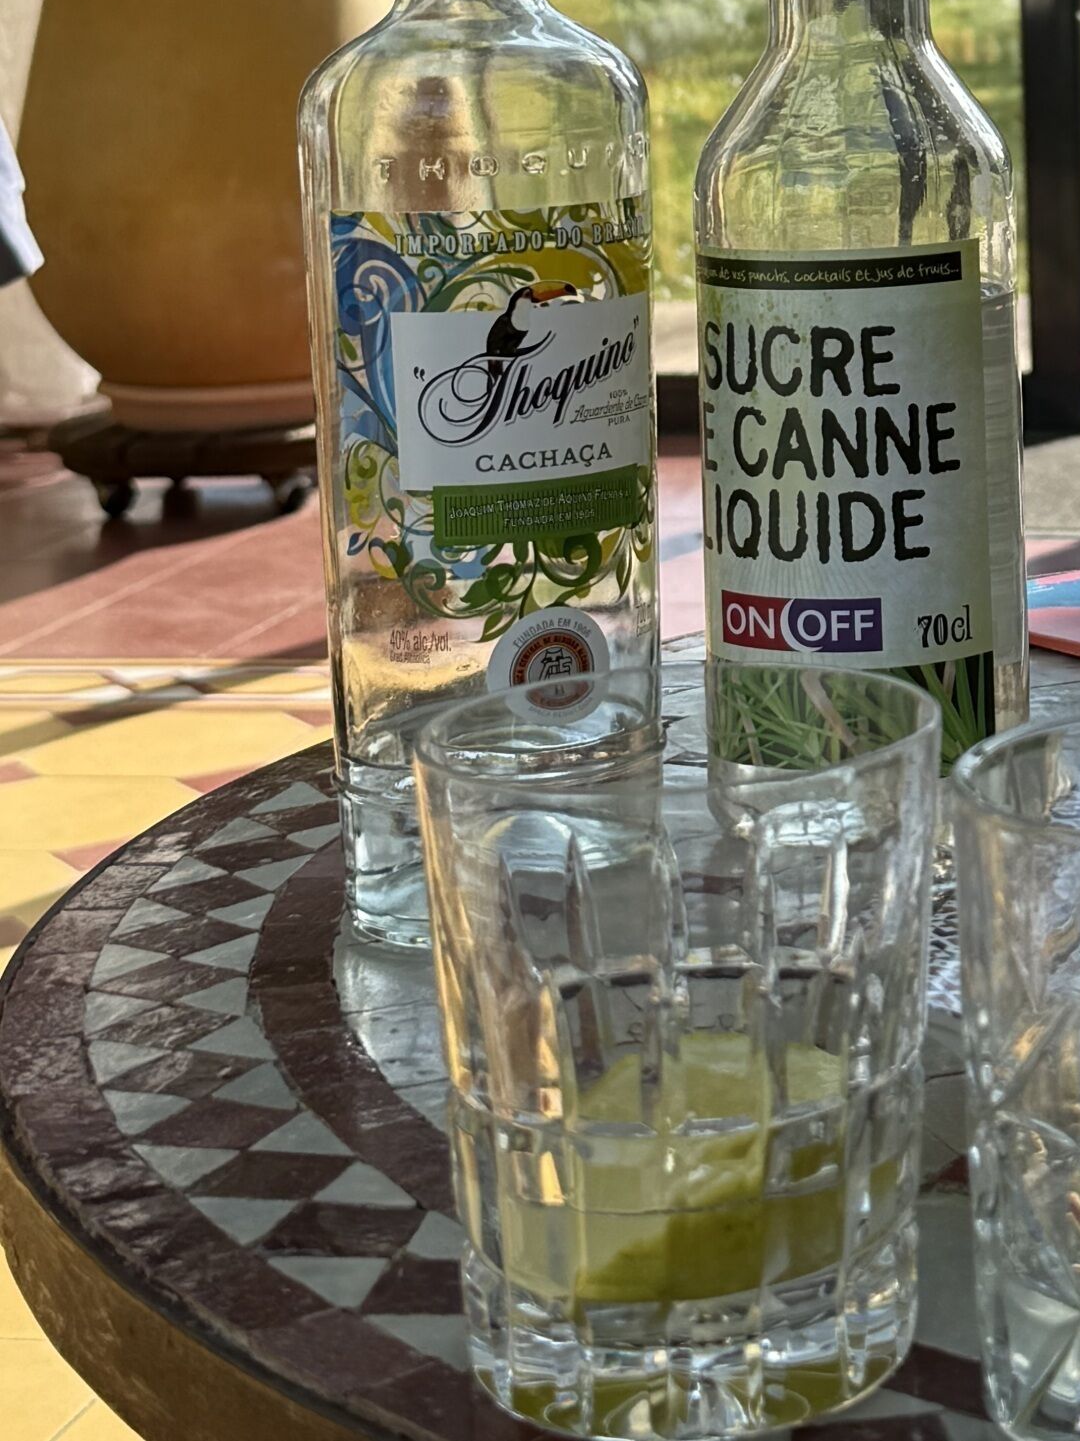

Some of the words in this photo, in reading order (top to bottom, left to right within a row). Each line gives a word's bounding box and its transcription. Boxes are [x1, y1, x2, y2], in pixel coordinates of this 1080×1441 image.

[395, 229, 545, 257] IMPORTADO
[557, 223, 583, 248] DO
[794, 268, 852, 283] cocktails
[897, 263, 915, 278] de
[704, 321, 901, 398] SUCRE
[607, 414, 631, 427] PURA
[702, 401, 719, 472] E
[733, 403, 961, 481] CANNE
[475, 442, 613, 474] CACHAÇA
[448, 503, 495, 520] JOAQUIM
[497, 499, 541, 513] THOMAZ
[543, 496, 556, 507] DE
[503, 512, 555, 528] FUNDADA
[558, 510, 572, 523] EM
[513, 618, 555, 649] FUNDADA
[557, 617, 572, 627] EM
[726, 603, 775, 640] ON
[797, 609, 875, 642] OFF
[389, 629, 411, 651] 40%
